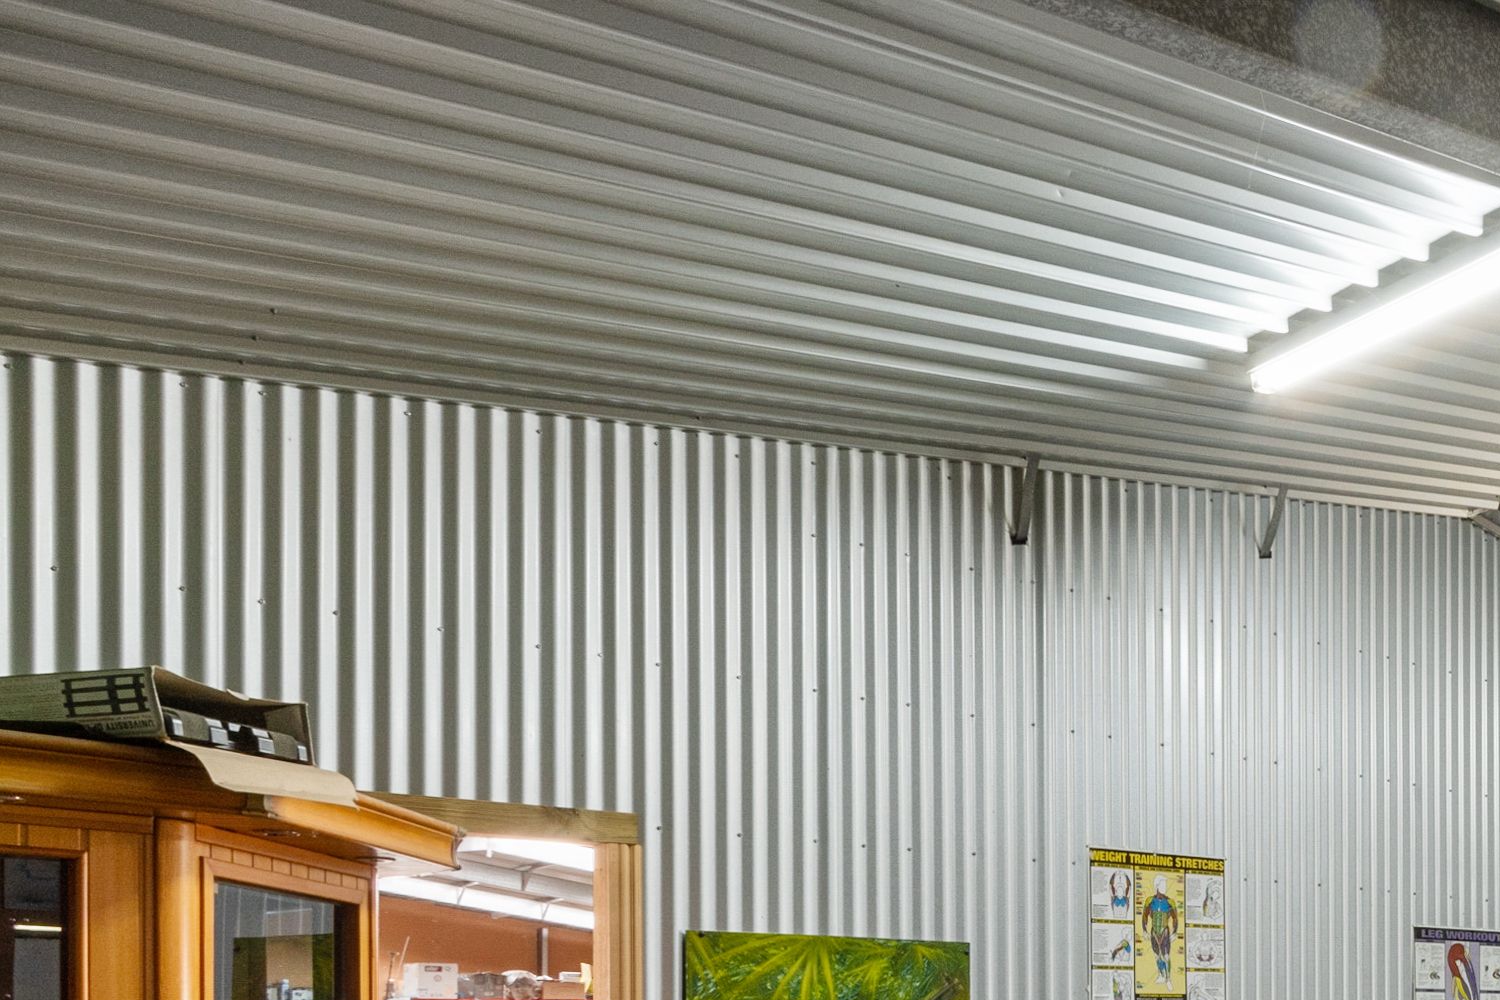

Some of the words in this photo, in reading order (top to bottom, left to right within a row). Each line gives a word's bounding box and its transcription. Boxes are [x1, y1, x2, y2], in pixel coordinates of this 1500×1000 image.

[1091, 850, 1127, 863] WEIGHT
[1129, 853, 1173, 867] TRAINING
[1175, 857, 1224, 870] STRETCHES
[1421, 928, 1443, 939] LEG
